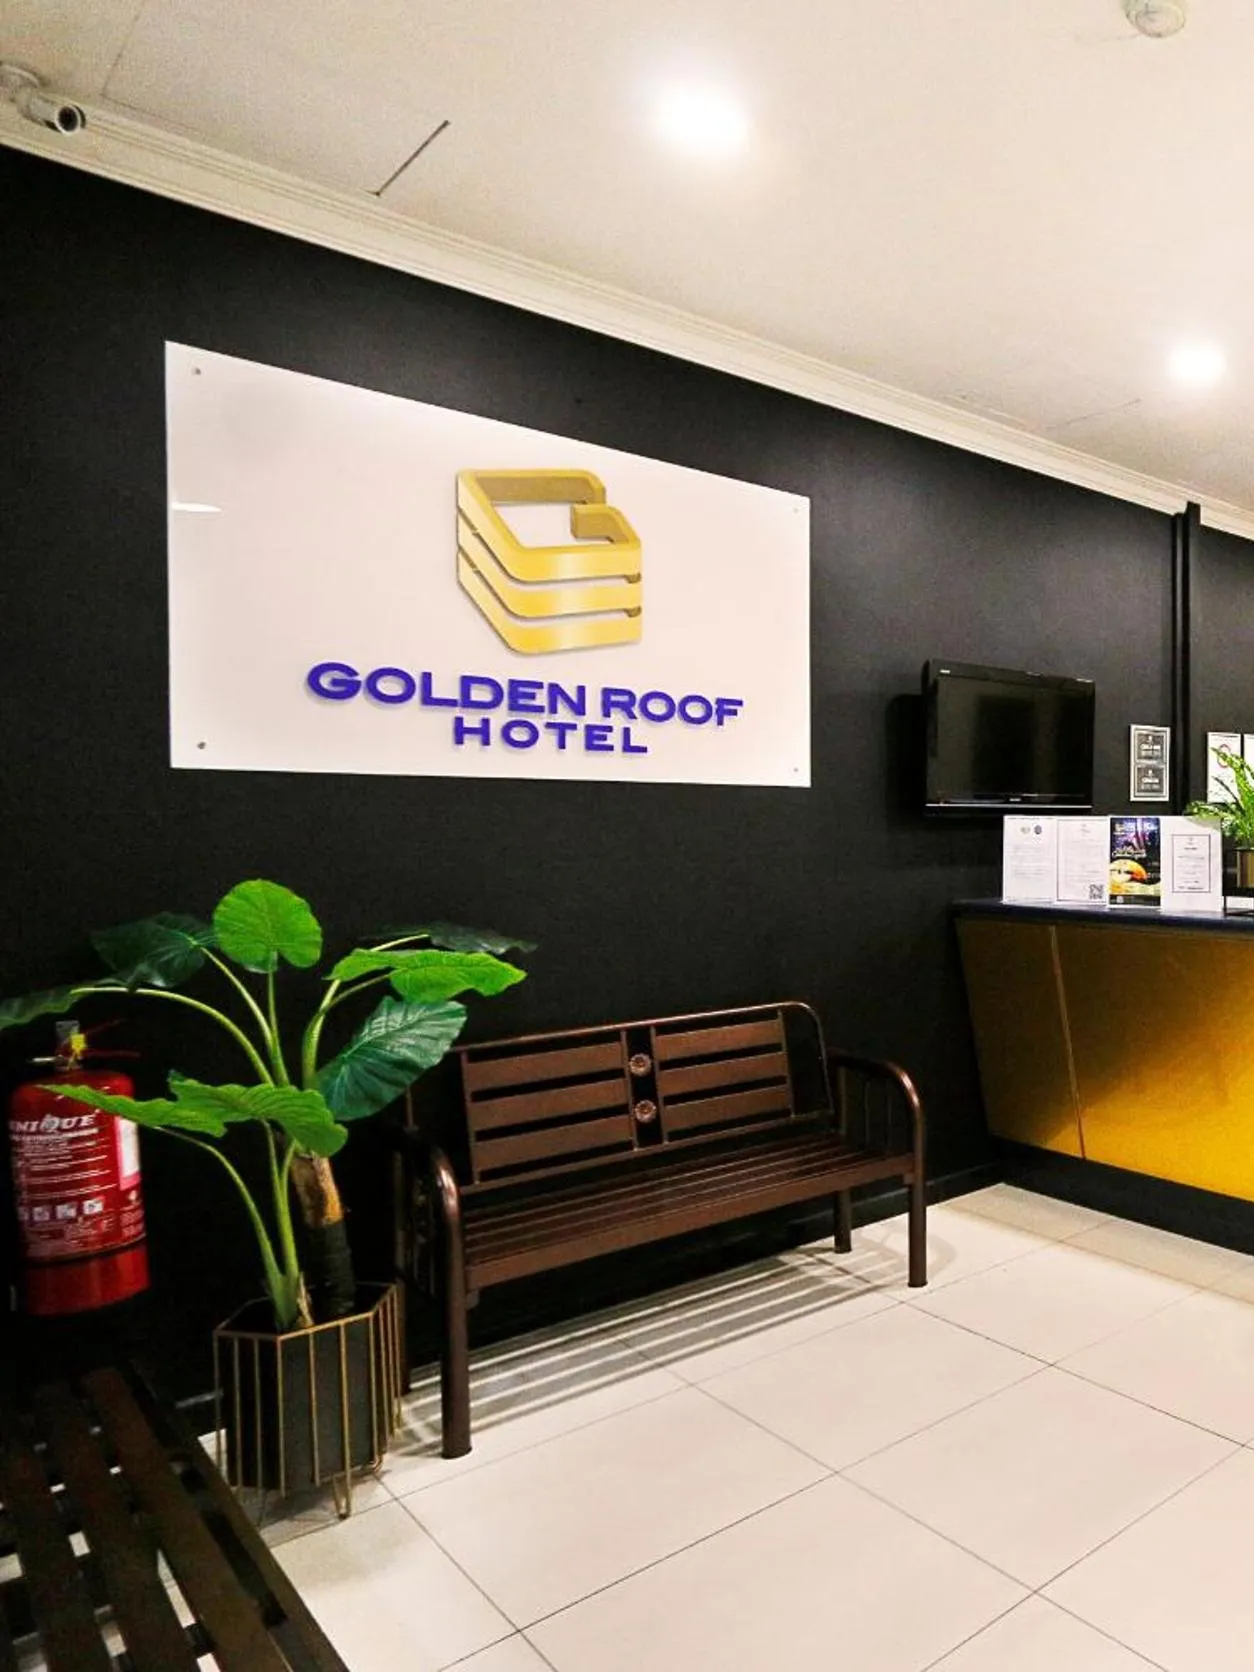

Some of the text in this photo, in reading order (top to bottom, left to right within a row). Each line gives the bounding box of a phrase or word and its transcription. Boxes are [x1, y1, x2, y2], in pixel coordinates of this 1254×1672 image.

[307, 662, 744, 726] GOLDEN ROOF
[454, 716, 648, 754] HOTEL
